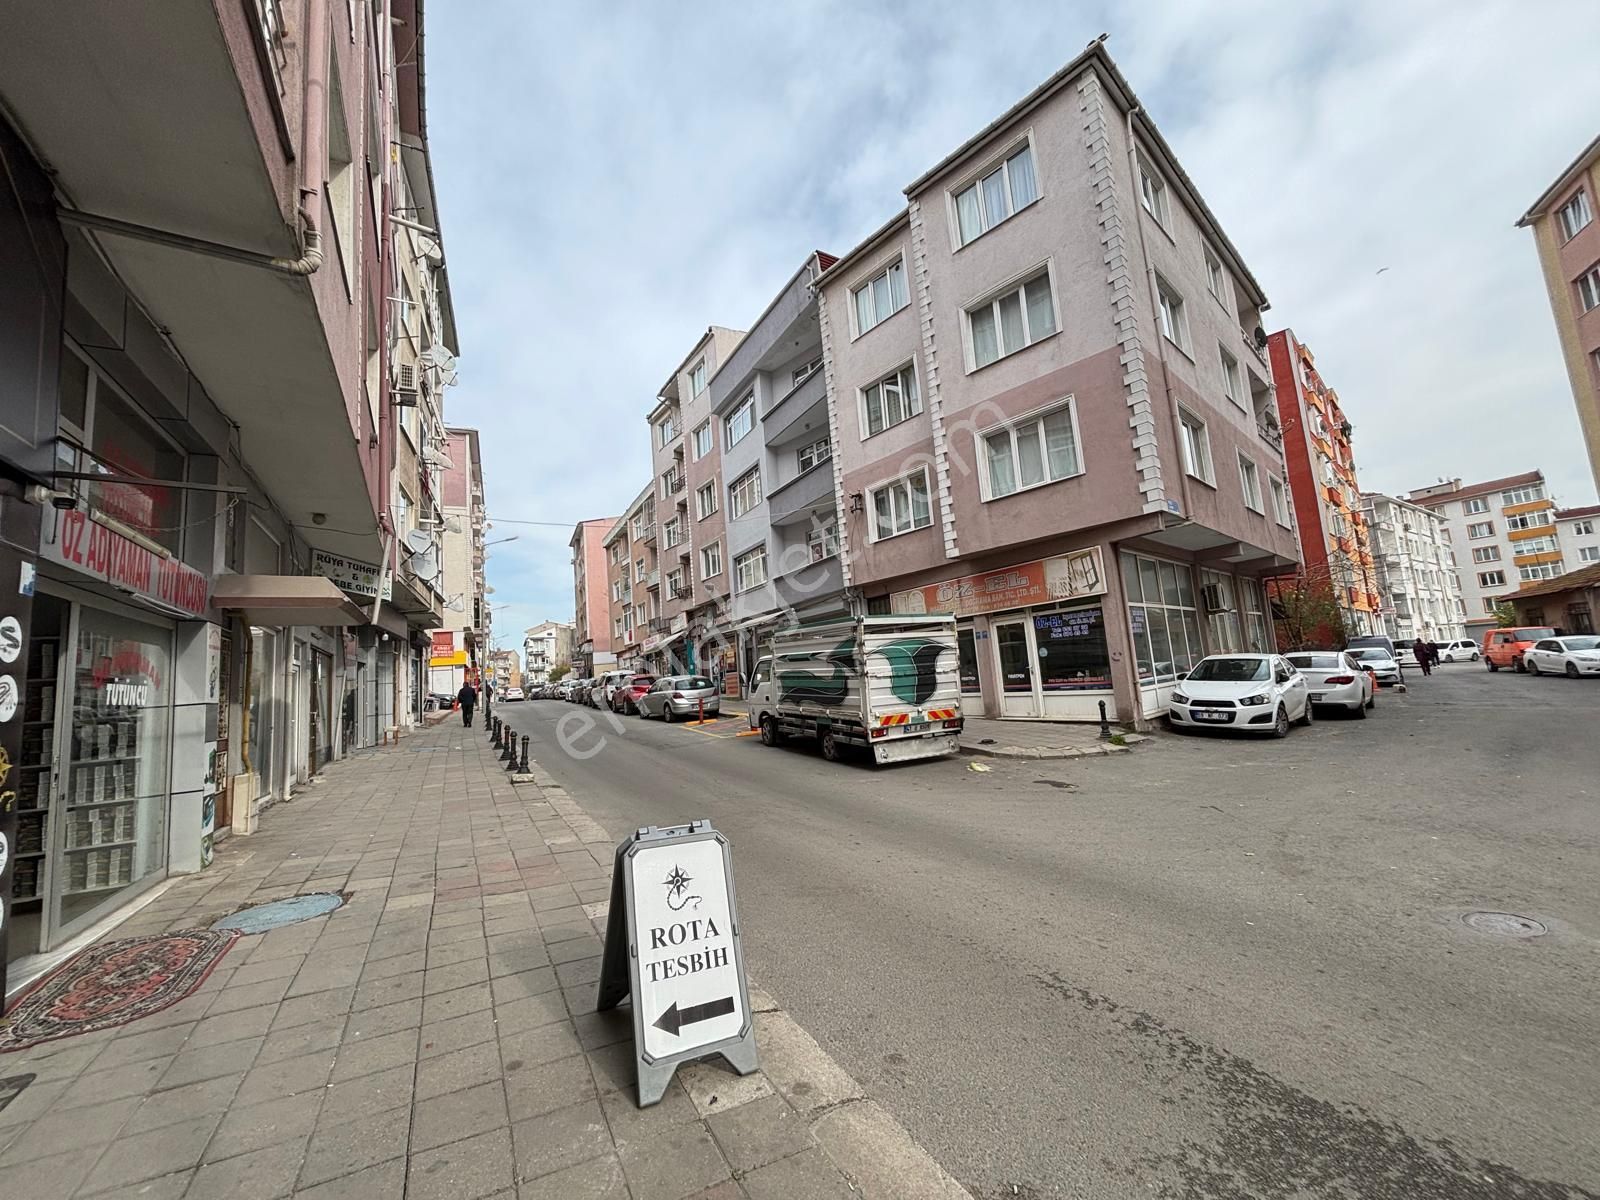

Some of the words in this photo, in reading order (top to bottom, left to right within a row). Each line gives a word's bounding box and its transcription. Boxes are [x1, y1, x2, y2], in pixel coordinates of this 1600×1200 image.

[331, 578, 353, 590] EBE
[351, 573, 359, 581] &
[105, 677, 148, 706] TÜTÜNCÜ
[650, 917, 720, 950] ROTA
[645, 945, 729, 983] TESBİH
